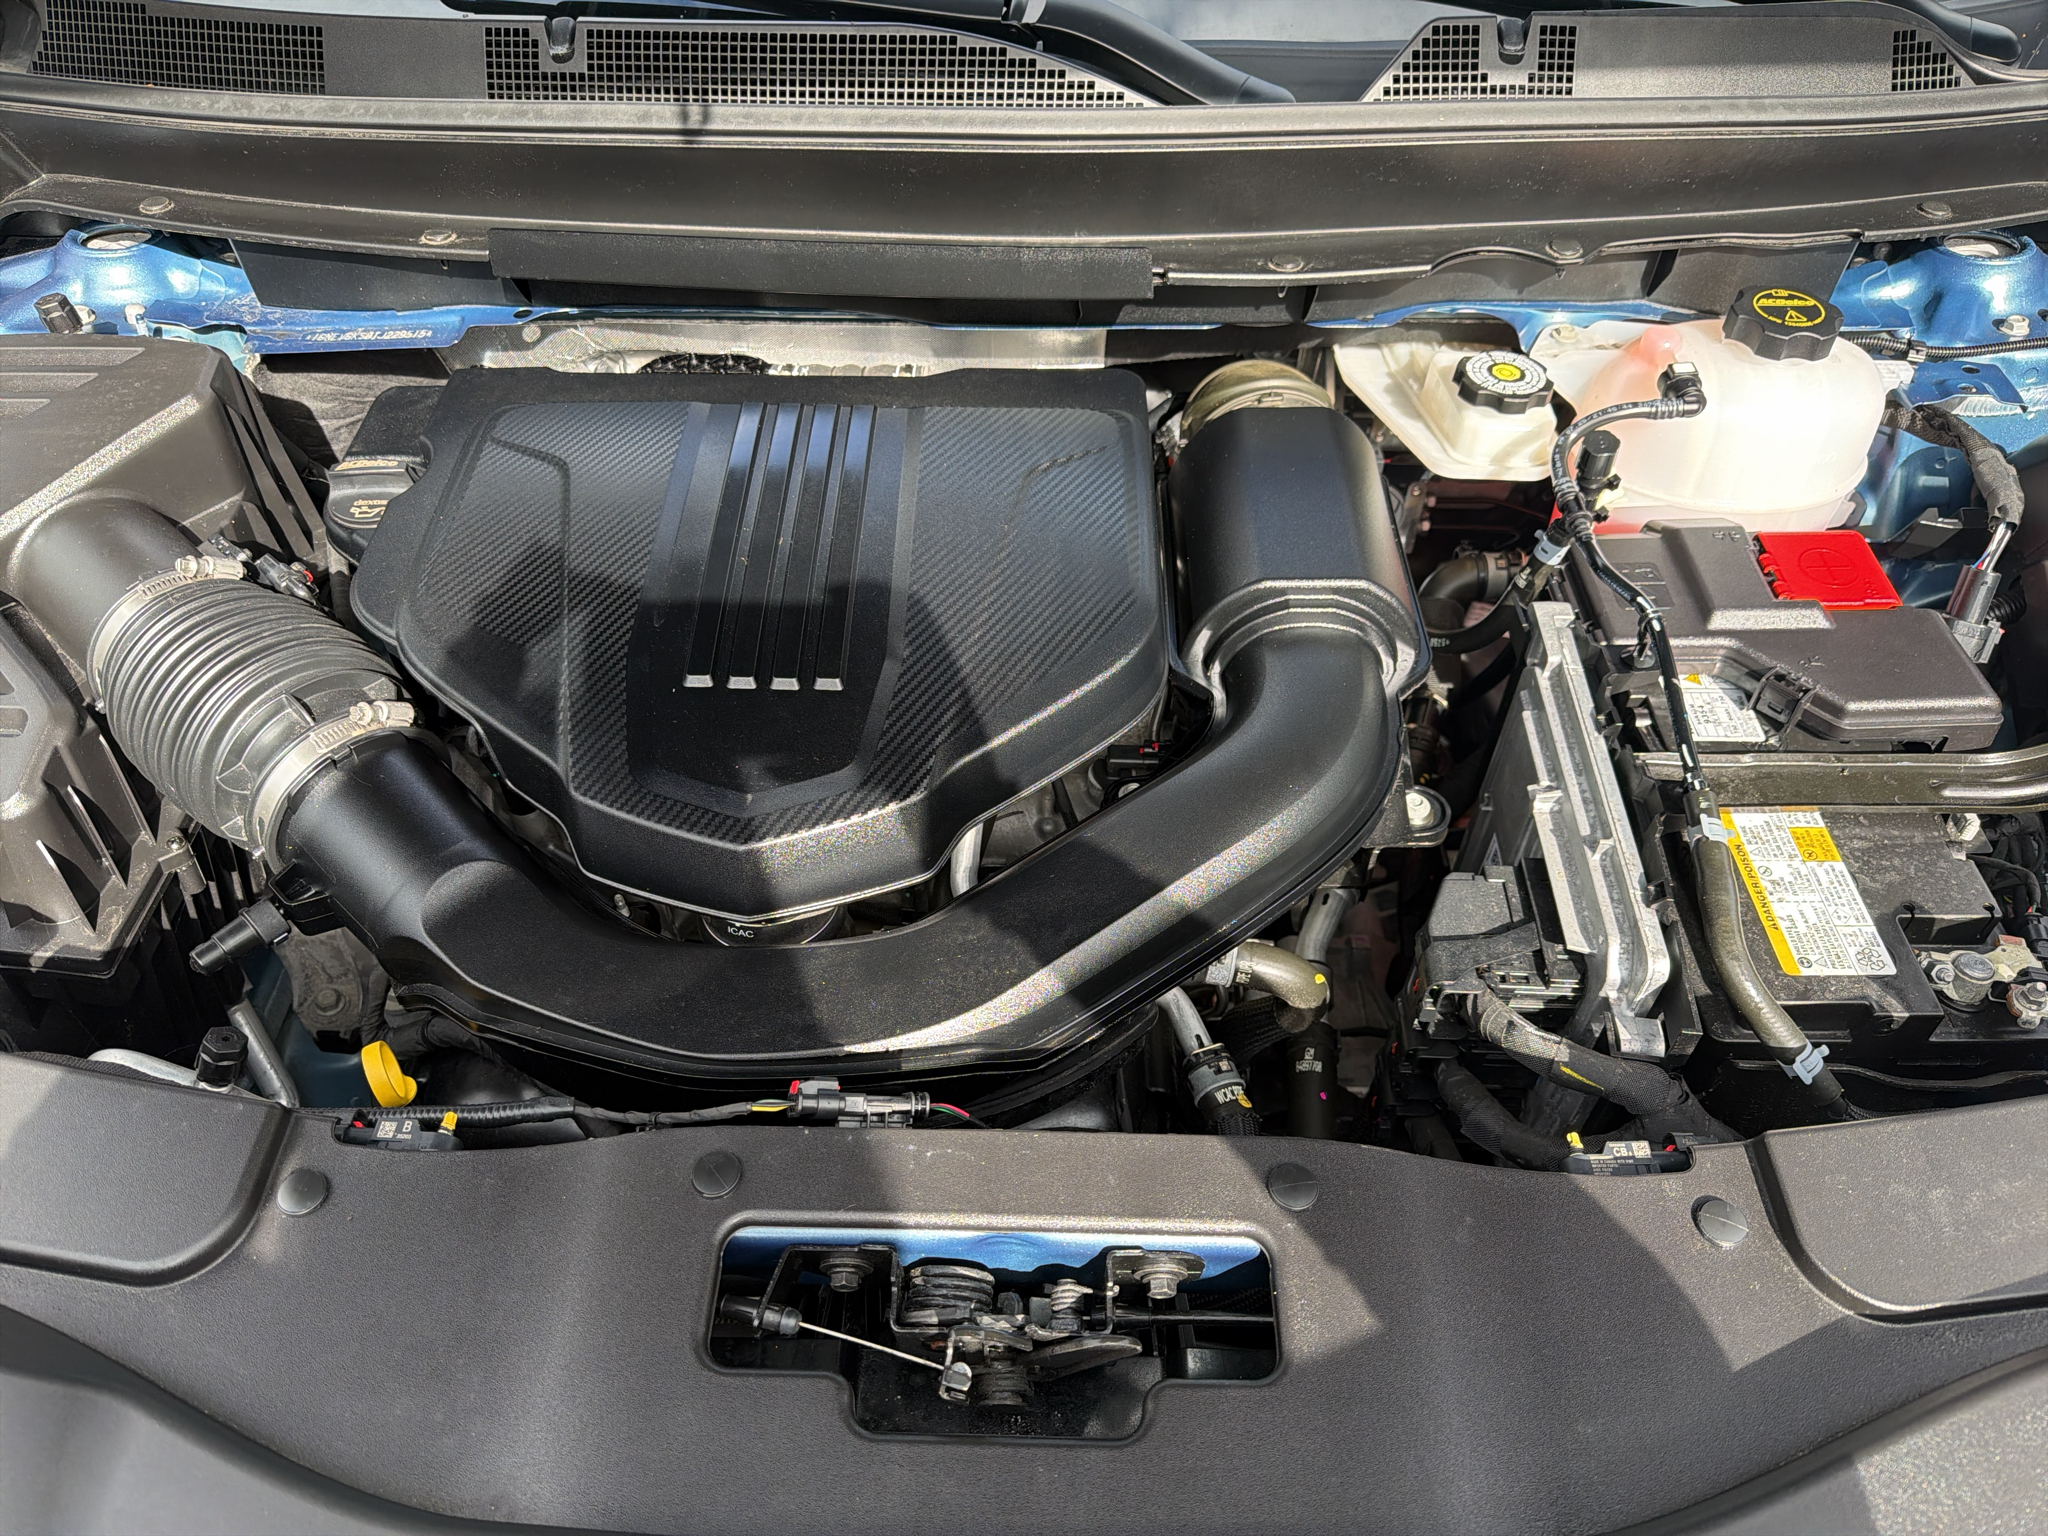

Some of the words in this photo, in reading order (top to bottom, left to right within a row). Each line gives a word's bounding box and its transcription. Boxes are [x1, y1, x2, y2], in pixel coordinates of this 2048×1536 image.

[1757, 298, 1815, 306] ACDelco
[335, 460, 399, 471] ACDelco
[1734, 843, 1775, 922] DANGER/POISON
[727, 926, 754, 938] ICAC
[402, 1120, 413, 1132] B
[1613, 1147, 1628, 1157] CB
